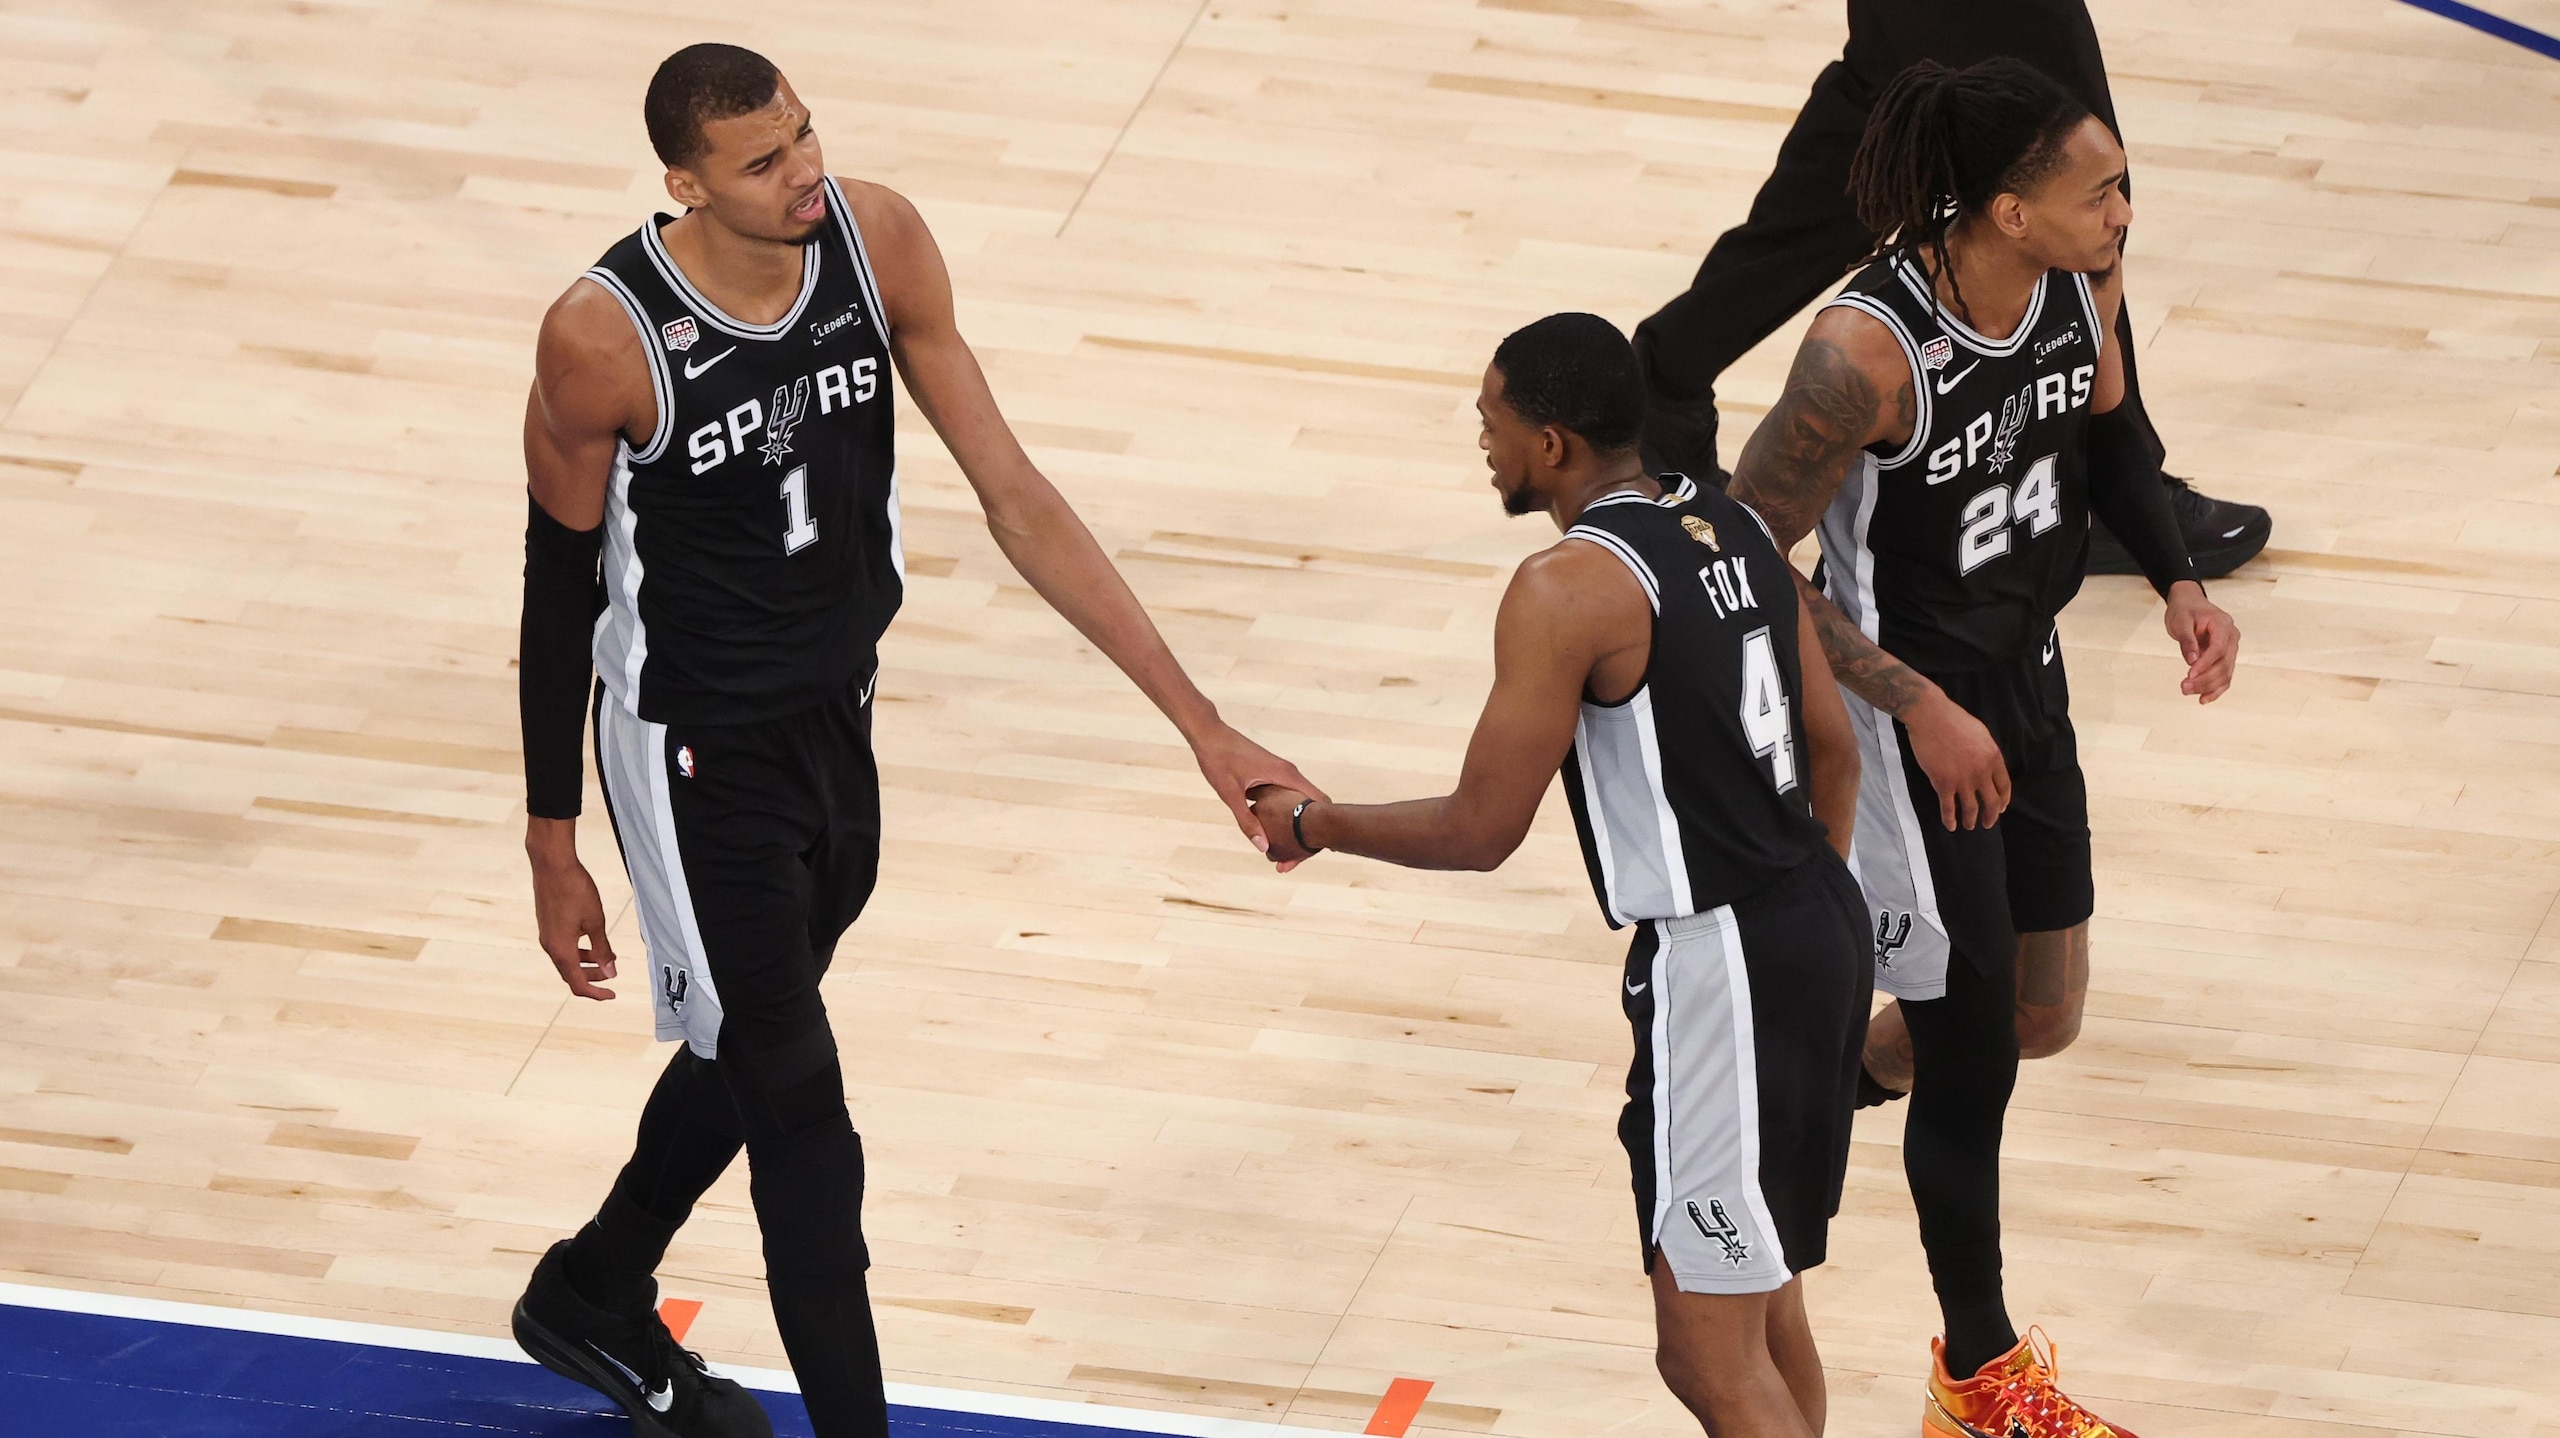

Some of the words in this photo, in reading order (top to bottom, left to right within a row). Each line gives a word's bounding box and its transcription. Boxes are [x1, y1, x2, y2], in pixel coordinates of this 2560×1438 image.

[666, 321, 692, 335] USA
[817, 311, 854, 338] LEDGER
[669, 332, 696, 348] 250
[1925, 340, 1948, 354] USA
[2040, 330, 2075, 357] LEDGER
[1927, 351, 1951, 367] 250
[780, 463, 819, 557] 1
[1957, 452, 2062, 578] 24
[1698, 556, 1758, 620] FOX
[1739, 625, 1798, 796] 4
